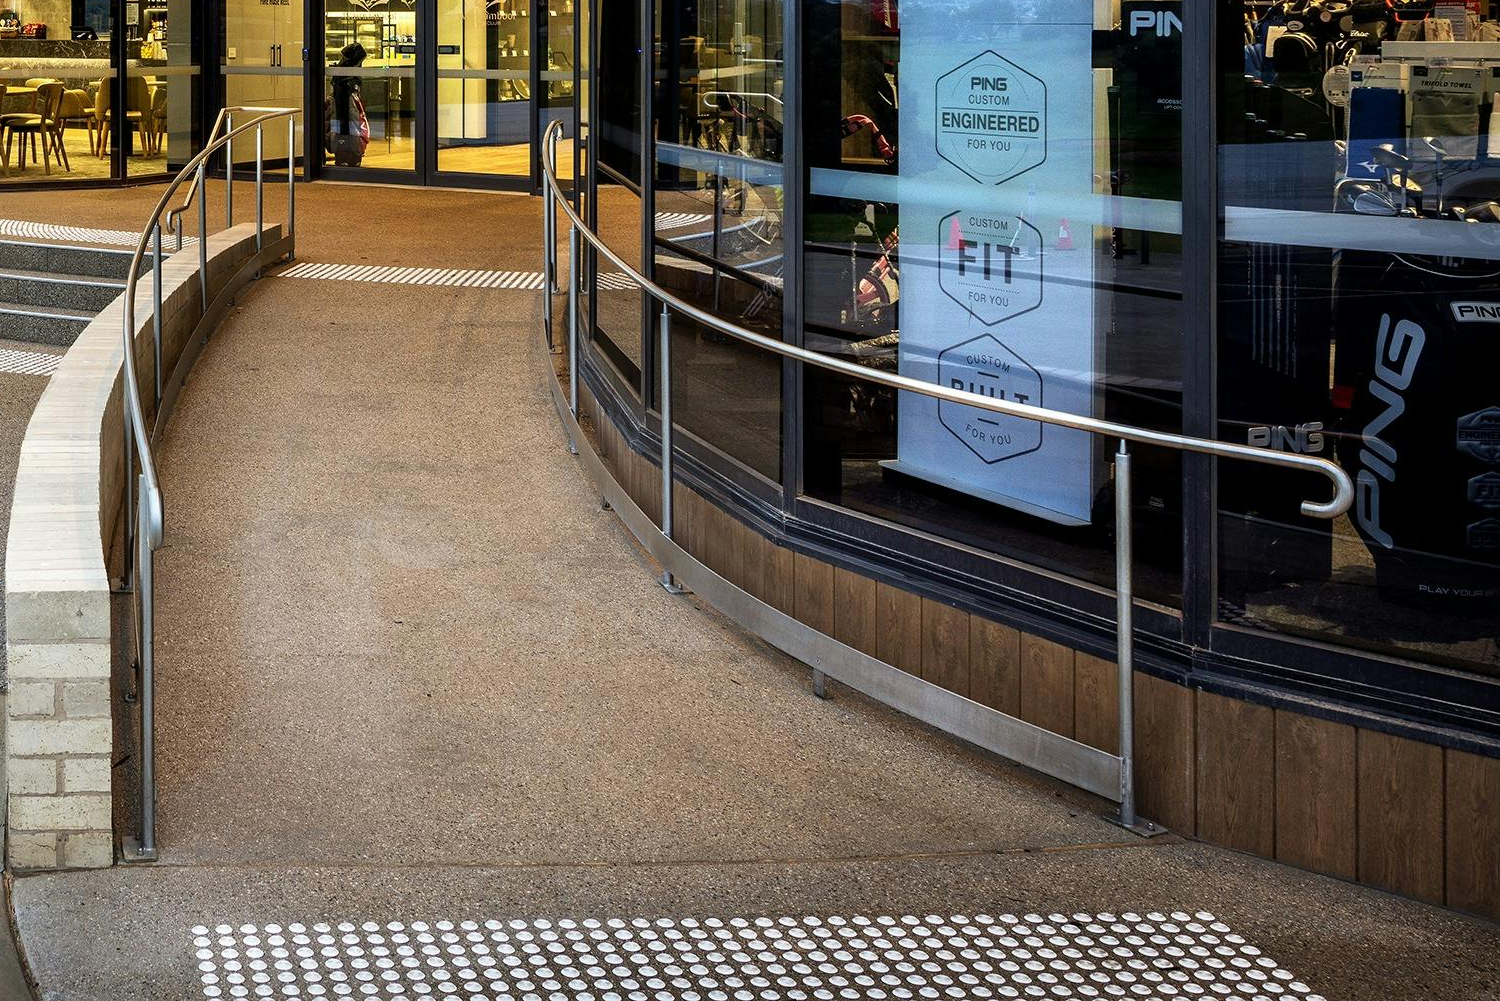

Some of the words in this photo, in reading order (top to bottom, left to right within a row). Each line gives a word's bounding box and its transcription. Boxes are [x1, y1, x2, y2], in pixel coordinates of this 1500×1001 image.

[1129, 11, 1182, 36] PIN
[971, 77, 1008, 91] PING
[1450, 81, 1473, 89] TOWEL
[968, 94, 1010, 105] CUSTOM
[942, 112, 1039, 133] ENGINEERED
[967, 139, 986, 149] FOR
[990, 141, 1011, 151] YOU
[969, 216, 1008, 230] CUSTOM
[959, 239, 1020, 284] FIT
[968, 291, 986, 303] FOR
[989, 295, 1009, 307] YOU
[1458, 305, 1500, 318] PIN
[966, 354, 1011, 373] CUSTOM
[965, 424, 986, 442] FOR
[990, 434, 1011, 445] YOU
[1247, 421, 1324, 453] PING
[1357, 312, 1426, 550] PING
[1458, 431, 1500, 440] ENGINE
[1419, 584, 1449, 595] PLAY
